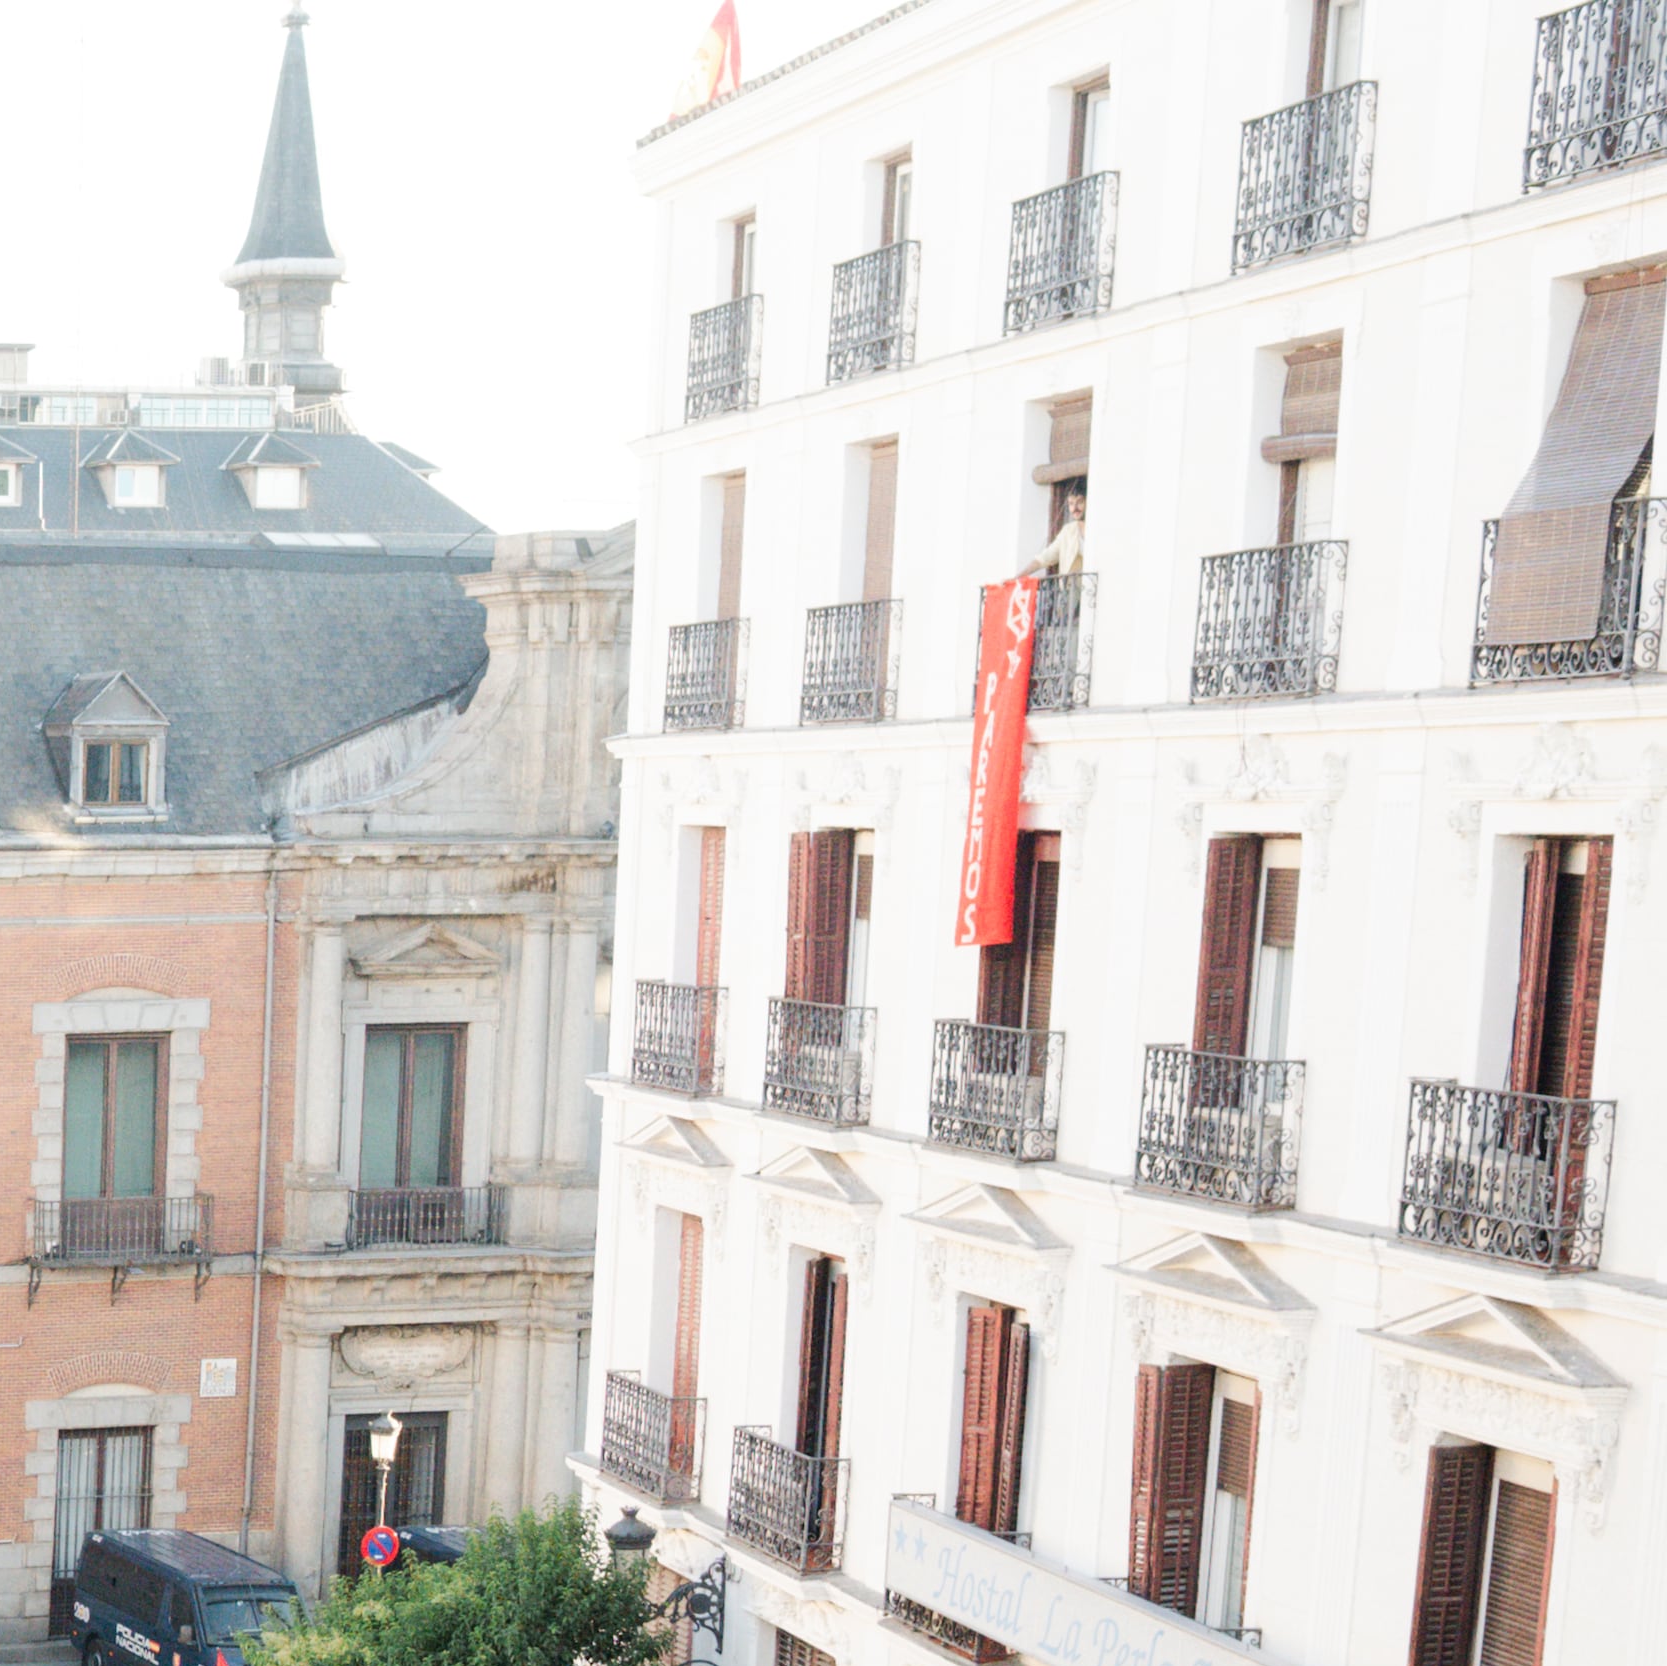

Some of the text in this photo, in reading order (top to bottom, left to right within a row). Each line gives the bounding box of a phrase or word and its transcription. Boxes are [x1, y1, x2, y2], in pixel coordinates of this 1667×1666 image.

[959, 671, 997, 944] PAREMOS
[116, 1622, 151, 1649] POLICIA
[935, 1546, 1033, 1635] Hostal
[1037, 1595, 1081, 1662] La
[115, 1634, 160, 1666] NACIONAL
